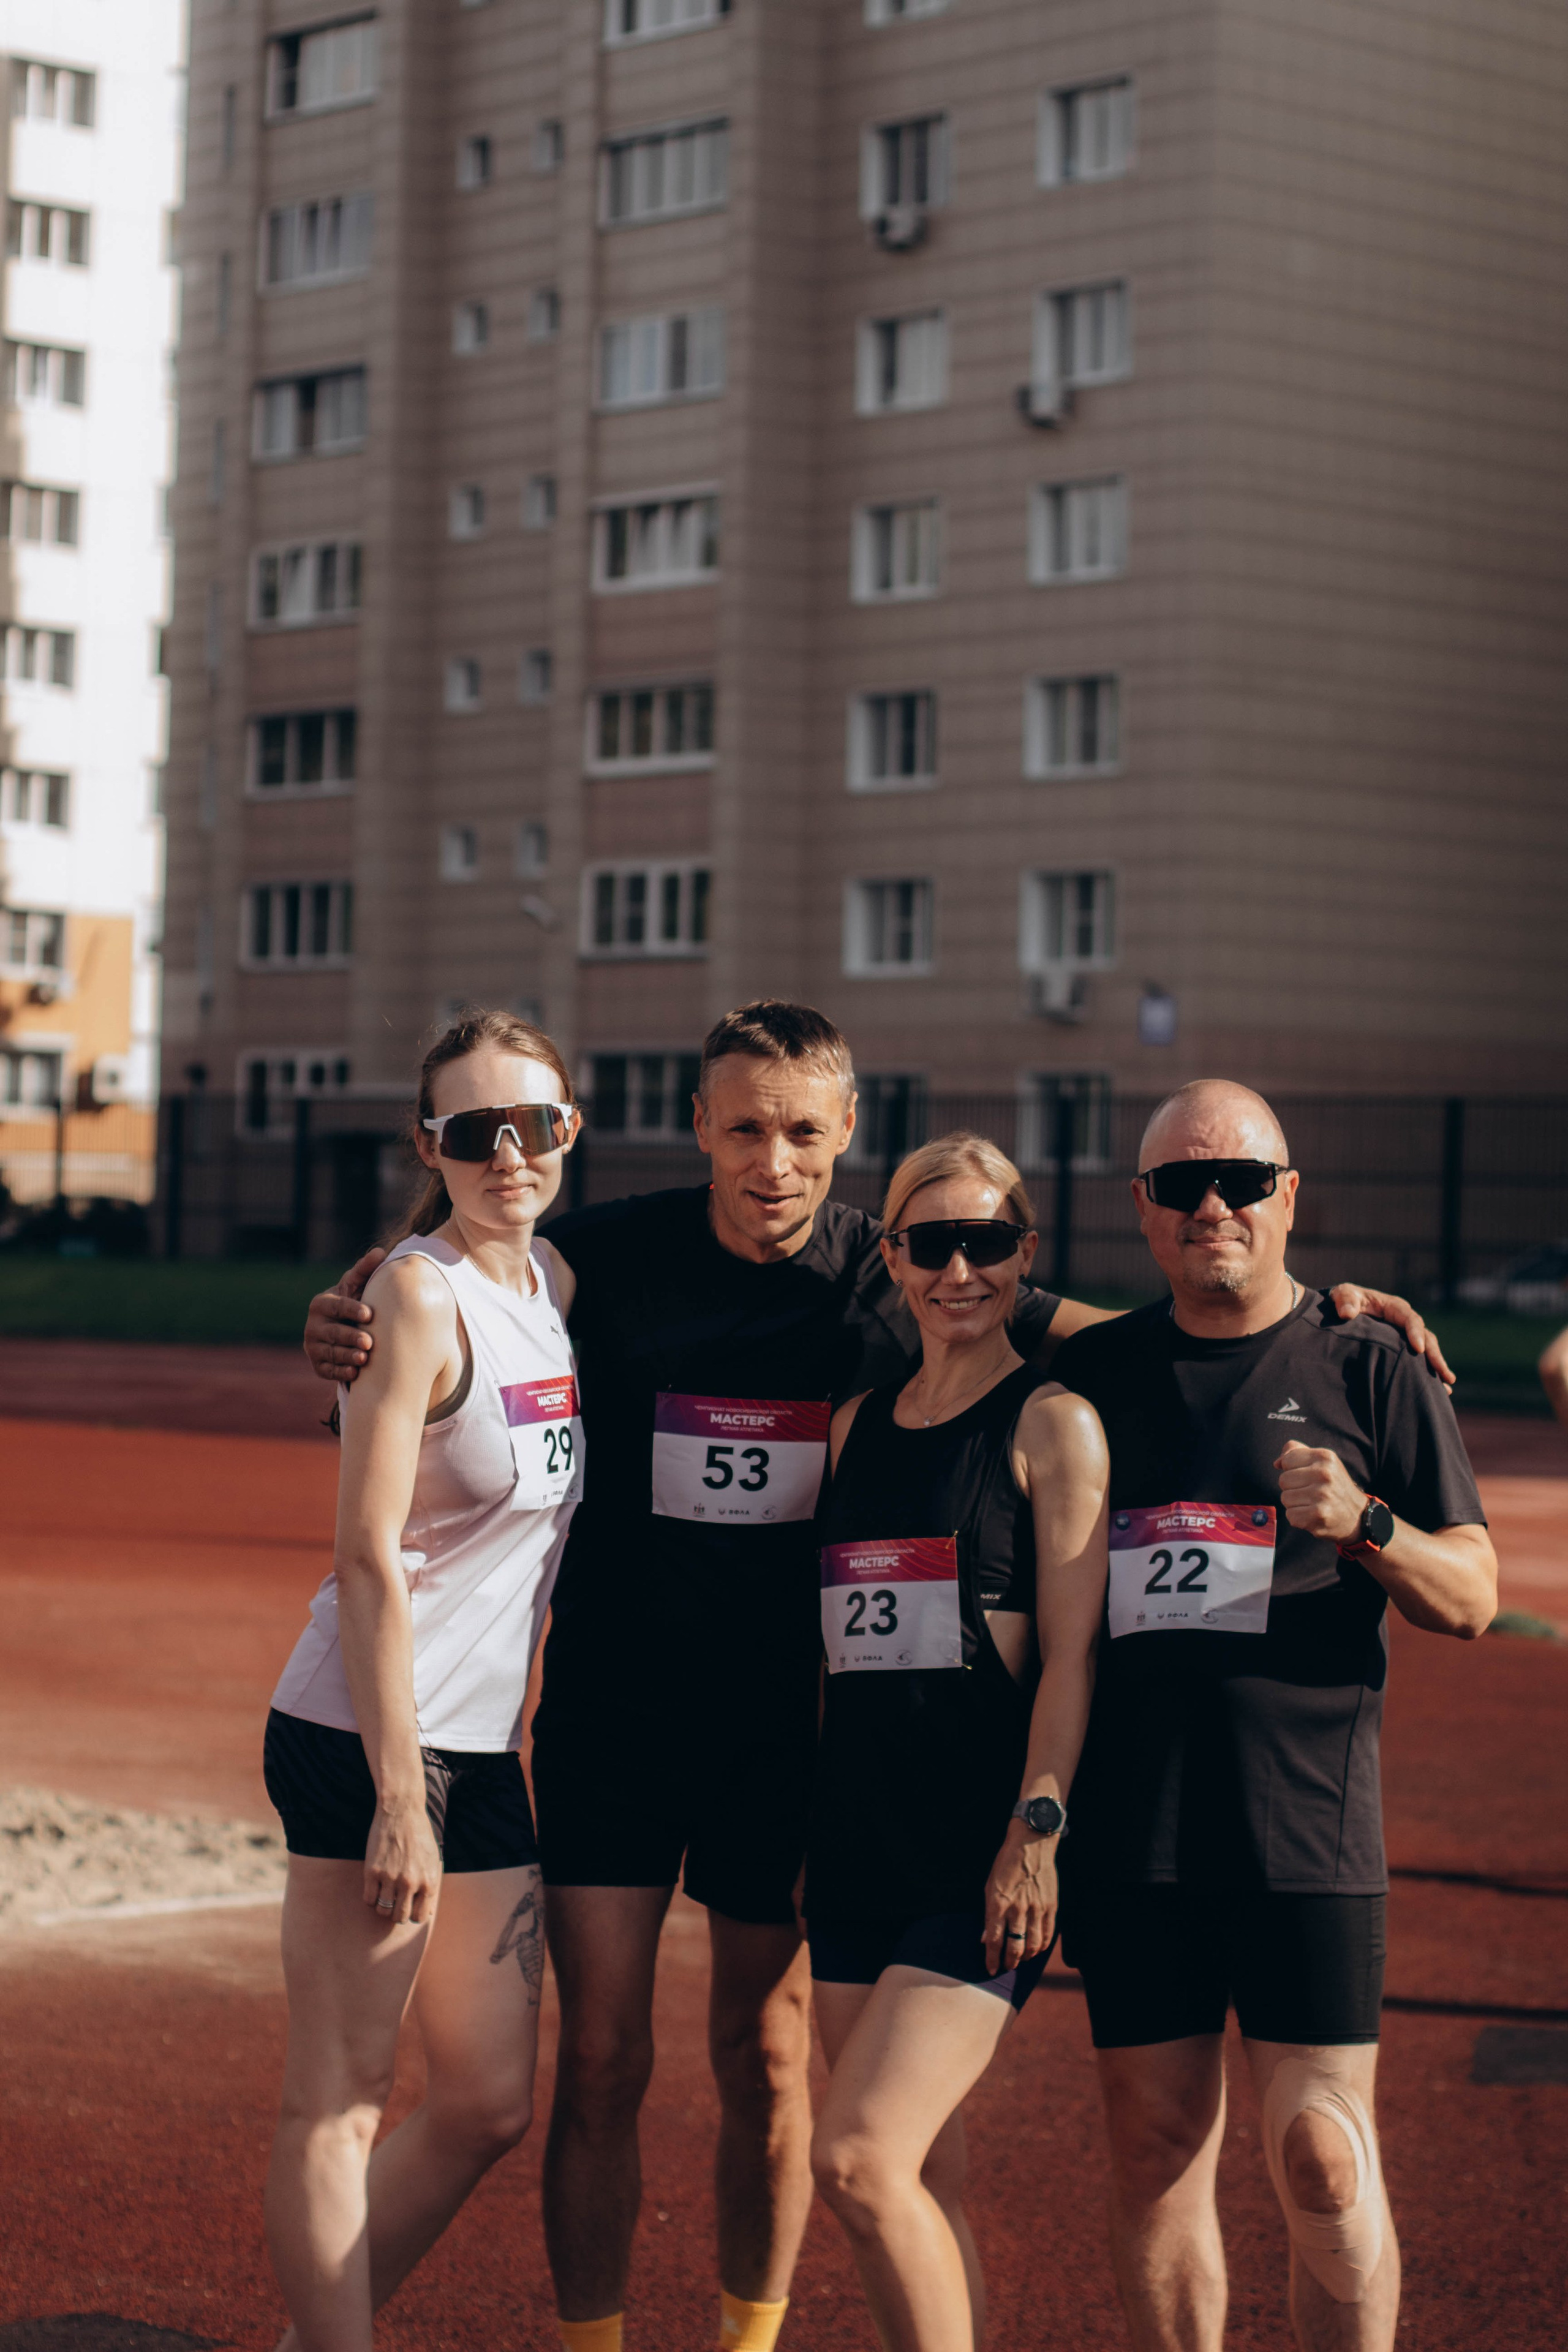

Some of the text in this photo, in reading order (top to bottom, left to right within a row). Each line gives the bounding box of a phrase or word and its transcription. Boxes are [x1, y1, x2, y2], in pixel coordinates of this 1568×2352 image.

[537, 1392, 567, 1407] МАСТЕРС
[710, 1412, 775, 1427] МАСТЕРС
[1267, 1412, 1308, 1423] DEMIX
[543, 1425, 573, 1474] 29
[701, 1445, 770, 1492] 53
[1156, 1515, 1216, 1529] МАСТЕРС
[849, 1556, 900, 1569] МАСТЕРС
[1144, 1548, 1210, 1596] 22
[844, 1589, 898, 1637] 23
